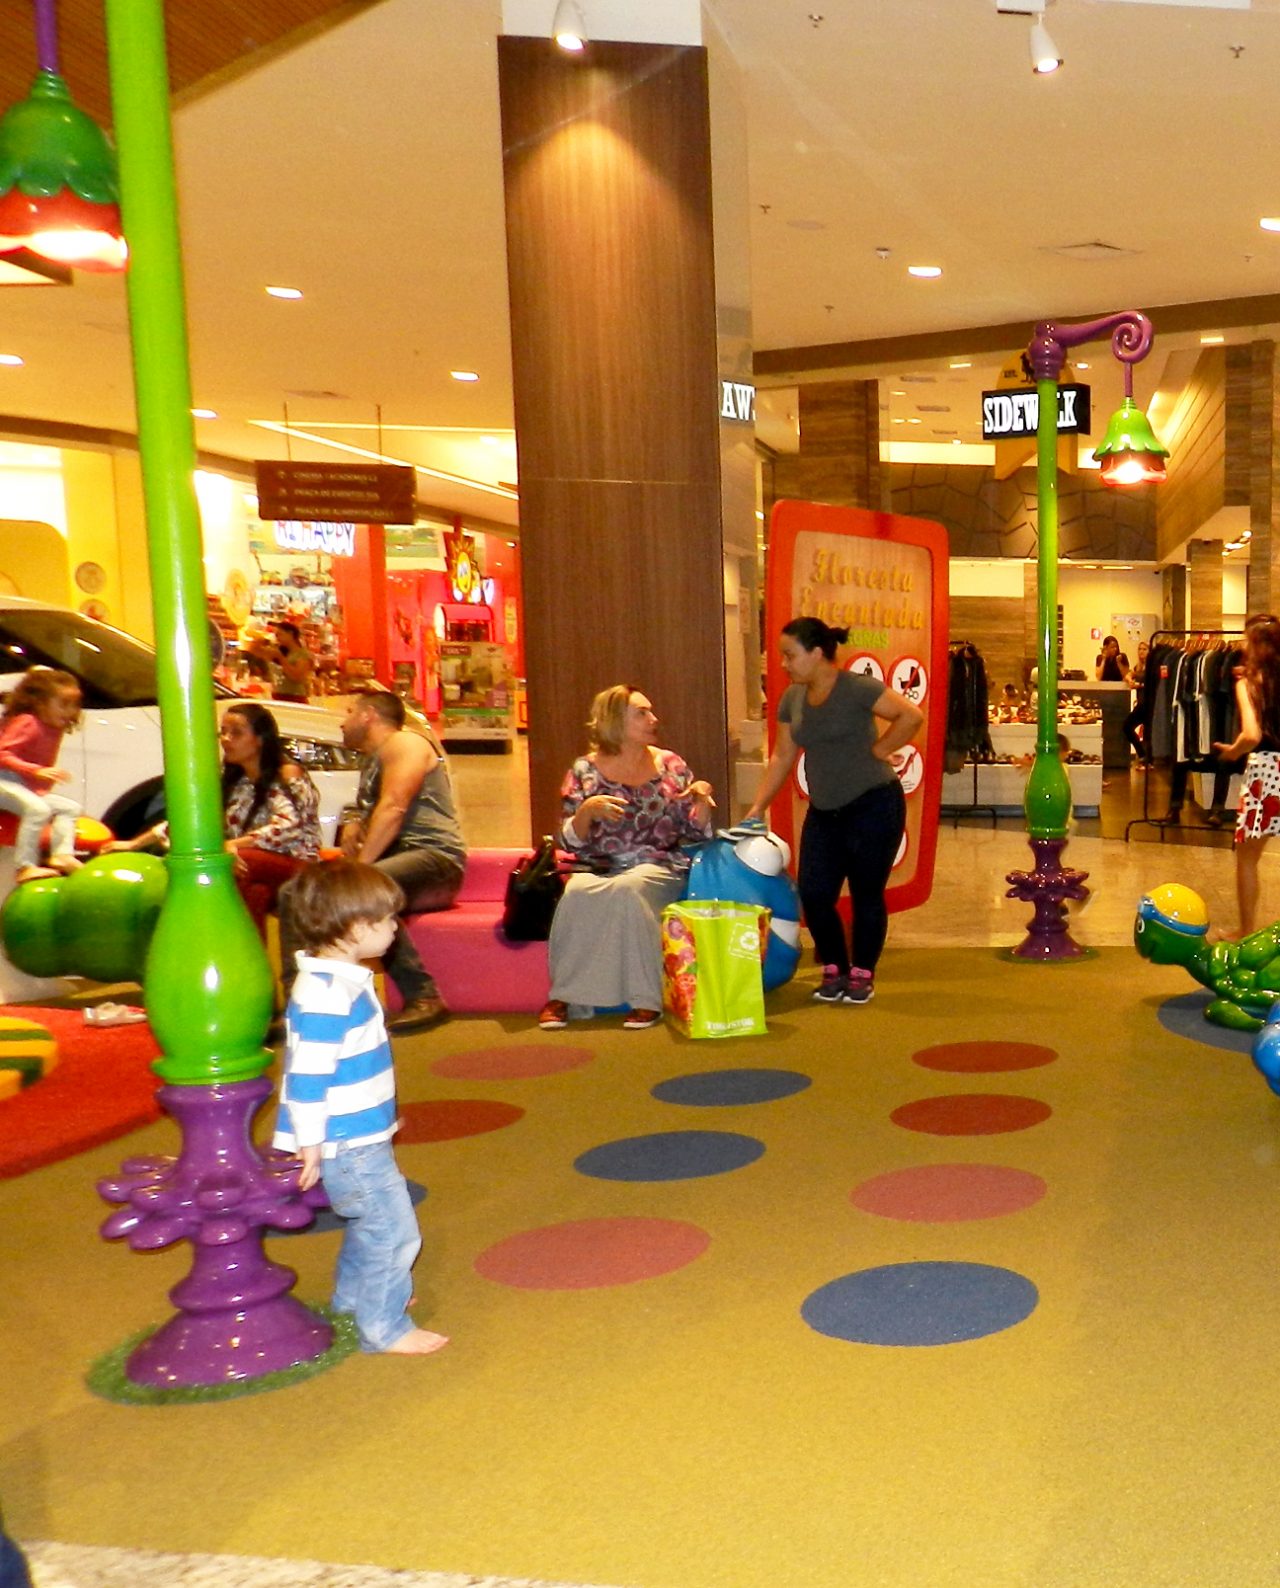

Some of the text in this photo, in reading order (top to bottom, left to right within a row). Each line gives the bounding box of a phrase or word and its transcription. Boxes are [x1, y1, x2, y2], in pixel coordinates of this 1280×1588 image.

[809, 547, 914, 593] Floresta
[799, 585, 924, 631] Encantada
[847, 629, 890, 649] EGRAS
